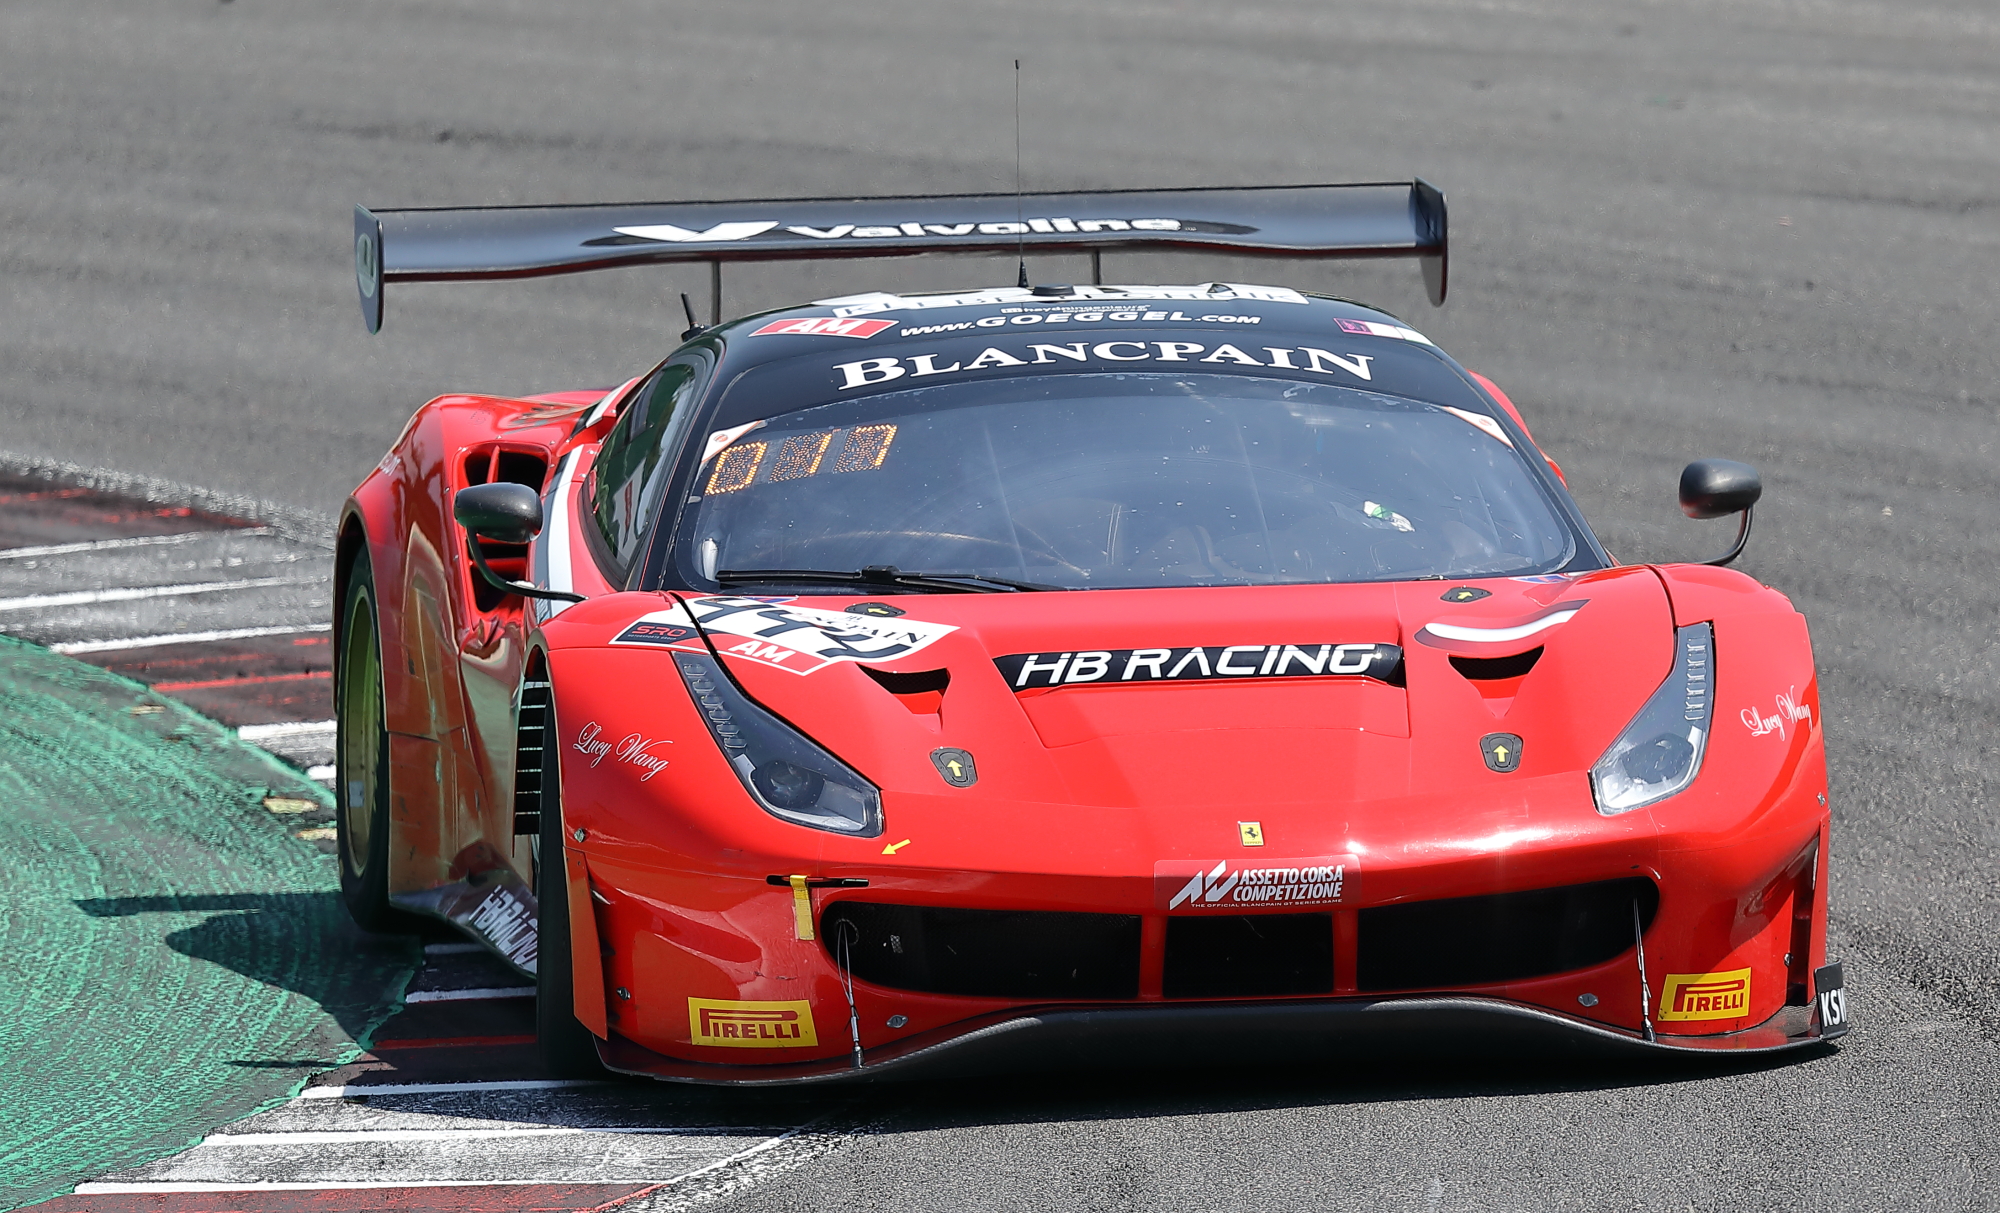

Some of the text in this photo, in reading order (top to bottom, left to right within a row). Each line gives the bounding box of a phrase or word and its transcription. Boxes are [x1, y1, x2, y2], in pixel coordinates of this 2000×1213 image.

[785, 217, 1182, 240] Valvoline
[777, 318, 867, 334] AM
[833, 341, 1375, 391] BLANCPAIN
[631, 625, 687, 637] SRO
[727, 640, 797, 663] AM
[1015, 643, 1376, 687] HB RACING
[1740, 685, 1813, 741] Lucy Wang
[573, 721, 674, 782] Lucy Wang
[1239, 865, 1343, 885] ASSETTO CORSA
[1233, 882, 1343, 902] COMPETIZIONE
[1673, 979, 1745, 1013] PIRELLI
[699, 1008, 800, 1038] PIRELLI
